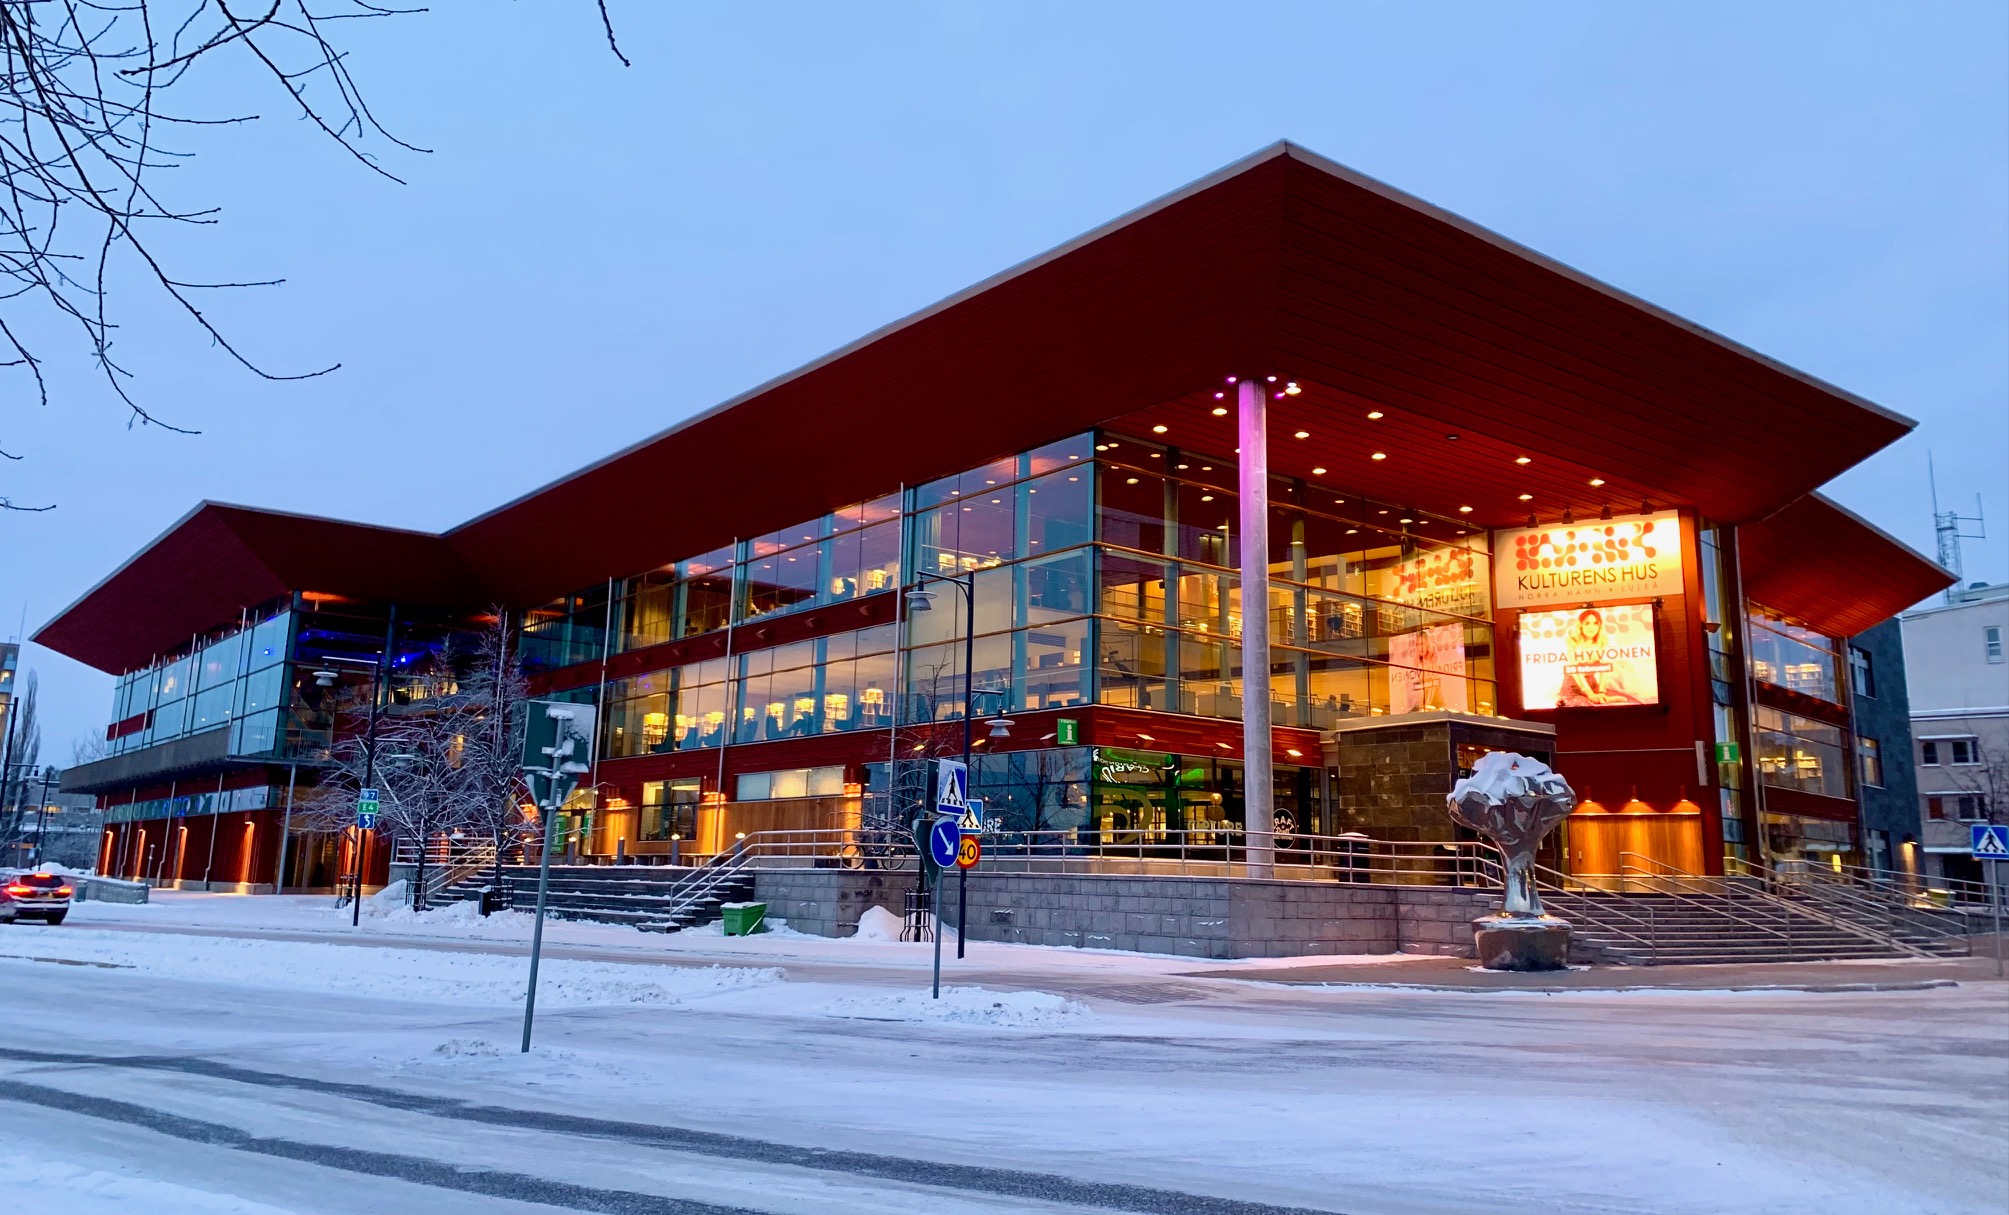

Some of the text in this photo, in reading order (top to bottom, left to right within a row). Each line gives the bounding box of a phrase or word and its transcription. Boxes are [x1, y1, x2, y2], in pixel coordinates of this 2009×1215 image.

[1518, 563, 1658, 591] KULTURENS HUS
[1518, 591, 1558, 600] NORRA
[1567, 588, 1601, 597] HAMN
[1525, 652, 1568, 664] FRIDA
[959, 844, 977, 860] 40
